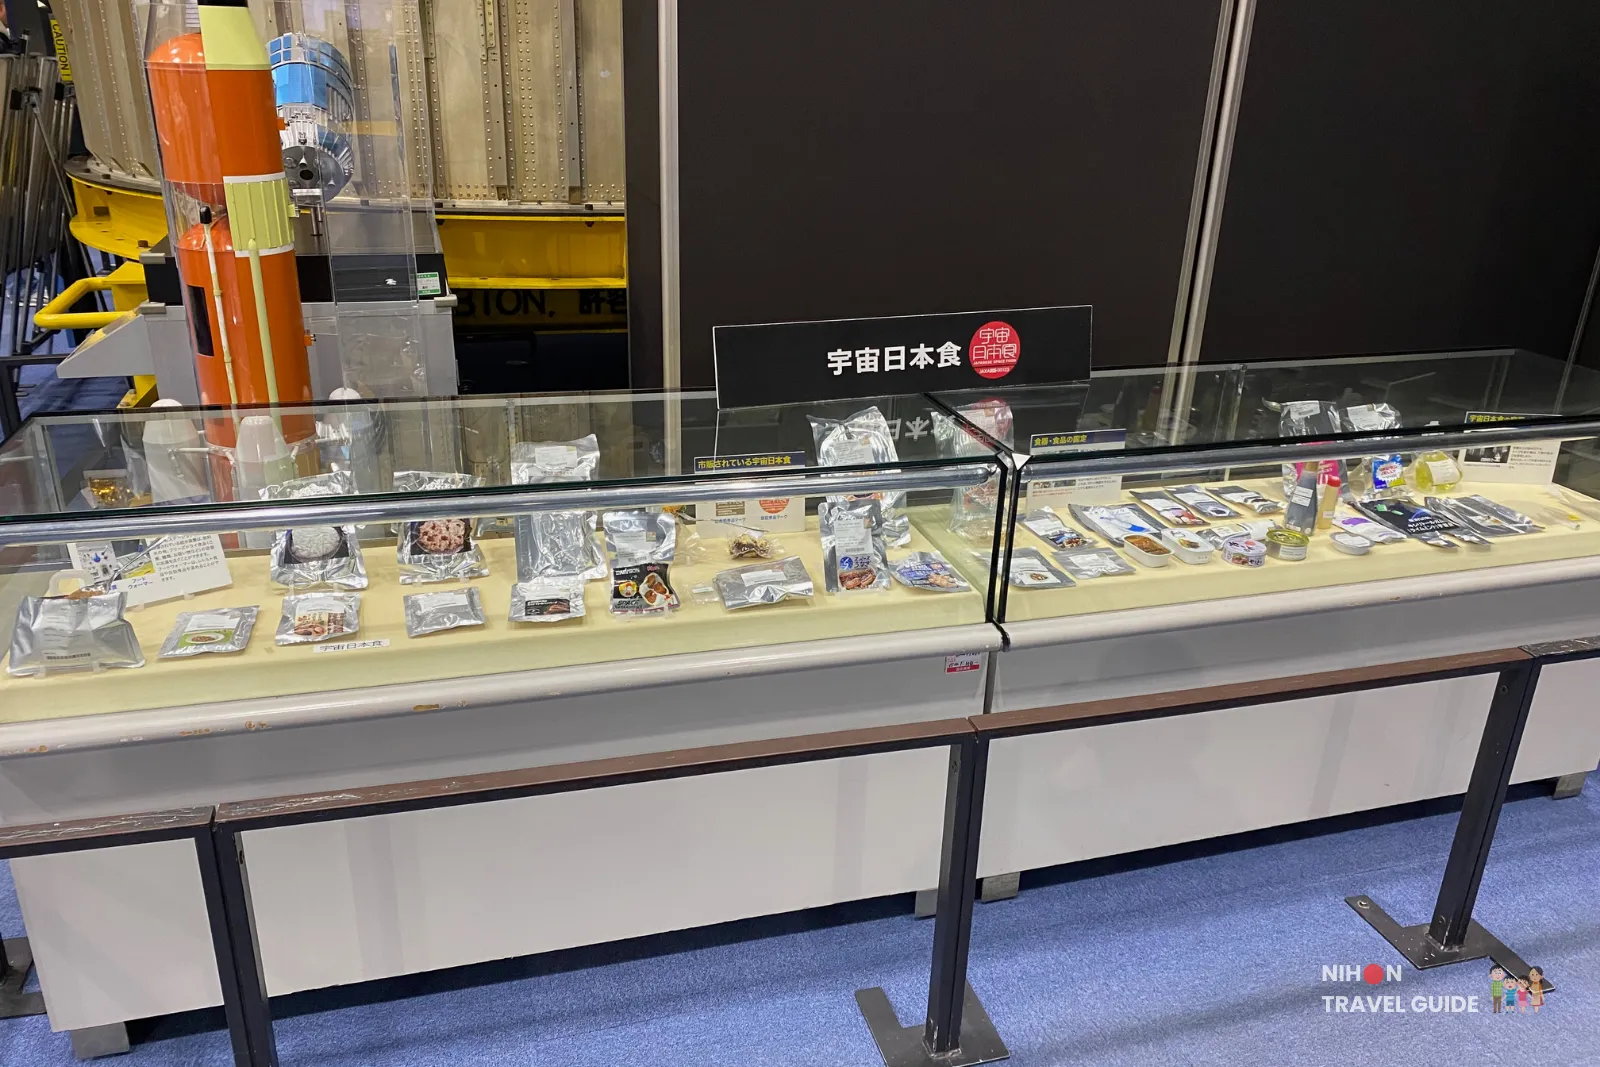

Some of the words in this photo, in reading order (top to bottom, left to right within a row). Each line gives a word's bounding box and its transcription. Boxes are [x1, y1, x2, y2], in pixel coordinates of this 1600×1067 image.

[979, 327, 1010, 344] 宇宙
[827, 341, 962, 376] 宇宙日本食
[973, 343, 1017, 360] 日本食
[698, 455, 791, 470] 市販されている宇宙日本食
[319, 640, 383, 651] 宇宙日本食
